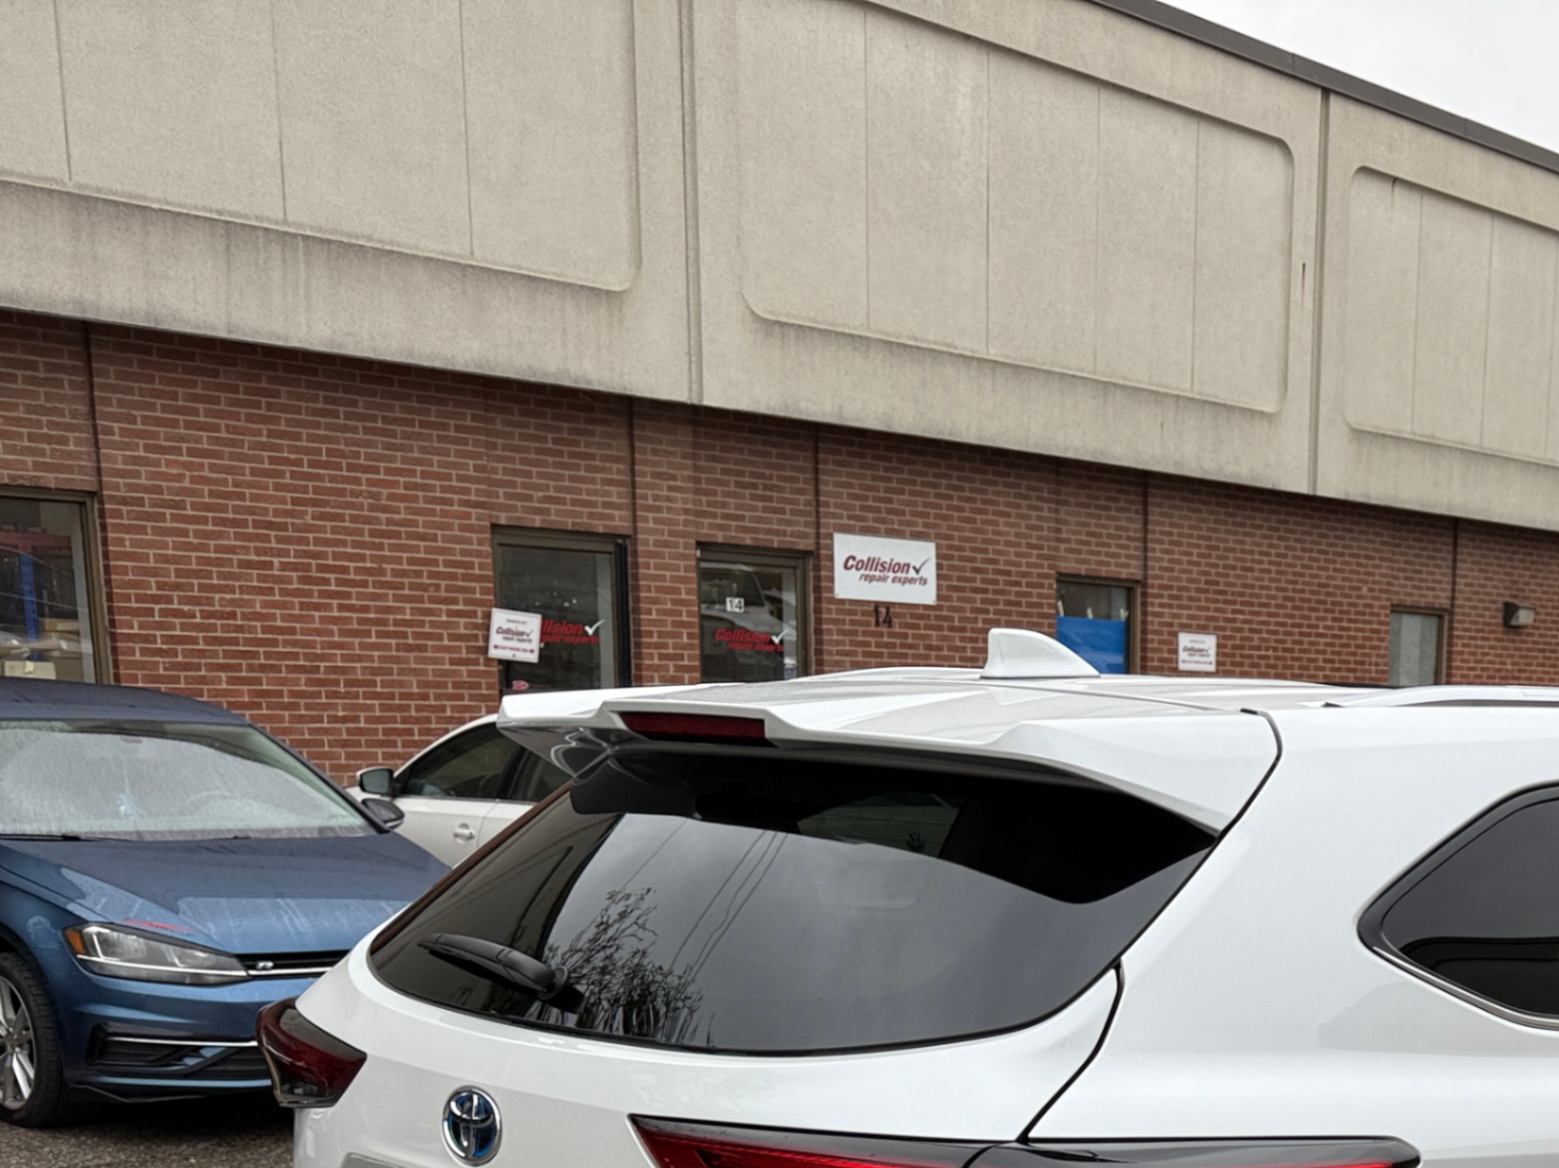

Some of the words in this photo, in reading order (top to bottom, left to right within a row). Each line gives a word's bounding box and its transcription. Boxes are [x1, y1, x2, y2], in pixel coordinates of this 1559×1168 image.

[843, 555, 911, 575] Collision
[859, 573, 890, 585] repair
[891, 575, 928, 587] experts
[728, 598, 743, 611] 14
[874, 604, 893, 628] 14
[541, 619, 582, 635] llision
[714, 628, 770, 643] Collision
